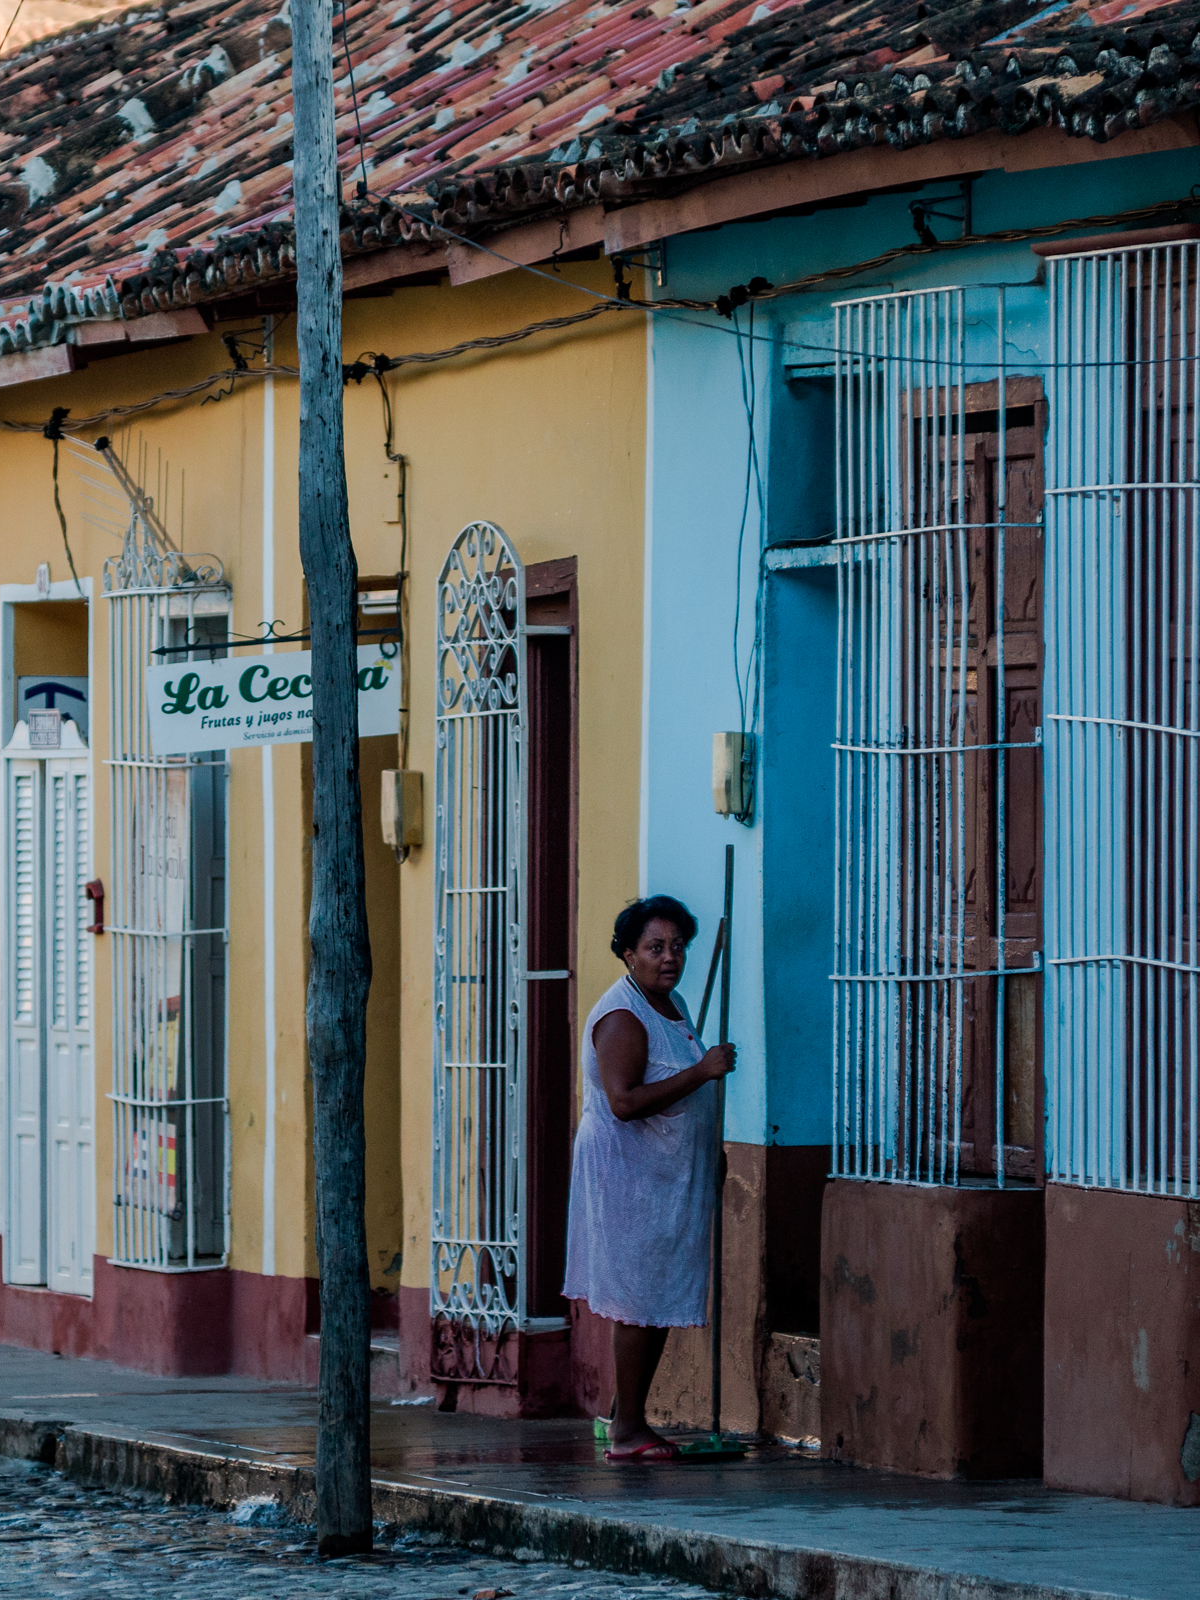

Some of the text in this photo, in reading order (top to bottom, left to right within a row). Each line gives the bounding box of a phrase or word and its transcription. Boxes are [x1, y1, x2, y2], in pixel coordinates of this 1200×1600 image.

[161, 664, 389, 715] La Ceca
[200, 715, 241, 729] Frutas
[245, 714, 255, 727] y
[257, 709, 293, 726] jugos
[243, 728, 275, 741] Servicio
[283, 726, 313, 736] domicil
